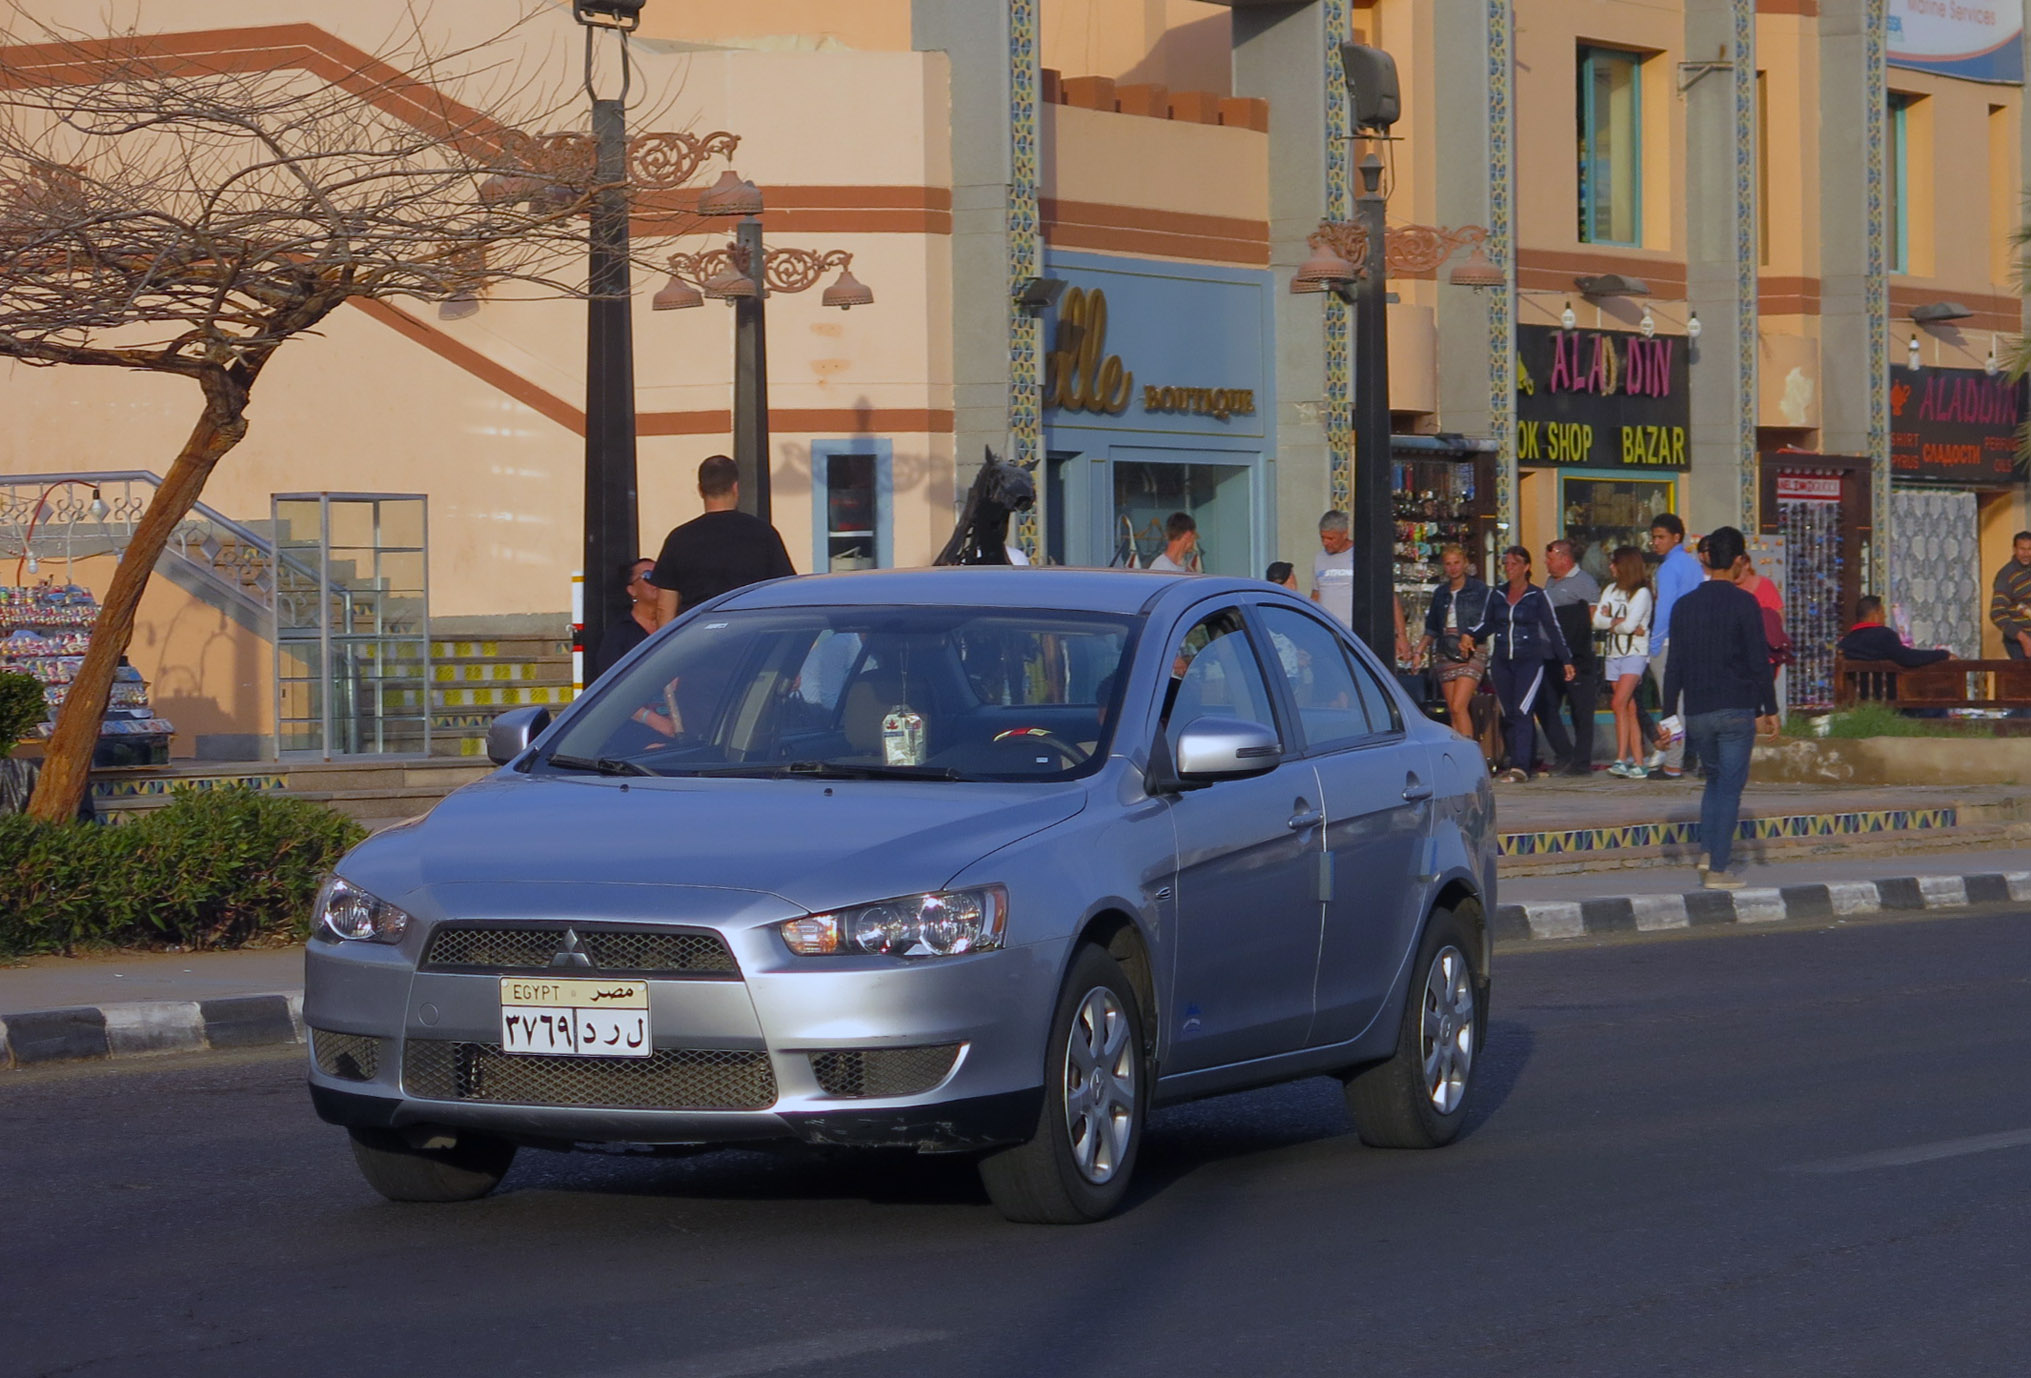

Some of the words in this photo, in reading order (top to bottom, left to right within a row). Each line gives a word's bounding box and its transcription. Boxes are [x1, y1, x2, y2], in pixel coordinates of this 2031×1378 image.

[1551, 330, 1673, 397] ALADDIN
[1144, 385, 1256, 420] BOUTIQUE
[1548, 423, 1593, 462] SHOP
[1622, 426, 1685, 464] BAZAR
[513, 984, 560, 1000] EGYPT
[589, 986, 634, 1002] مصر
